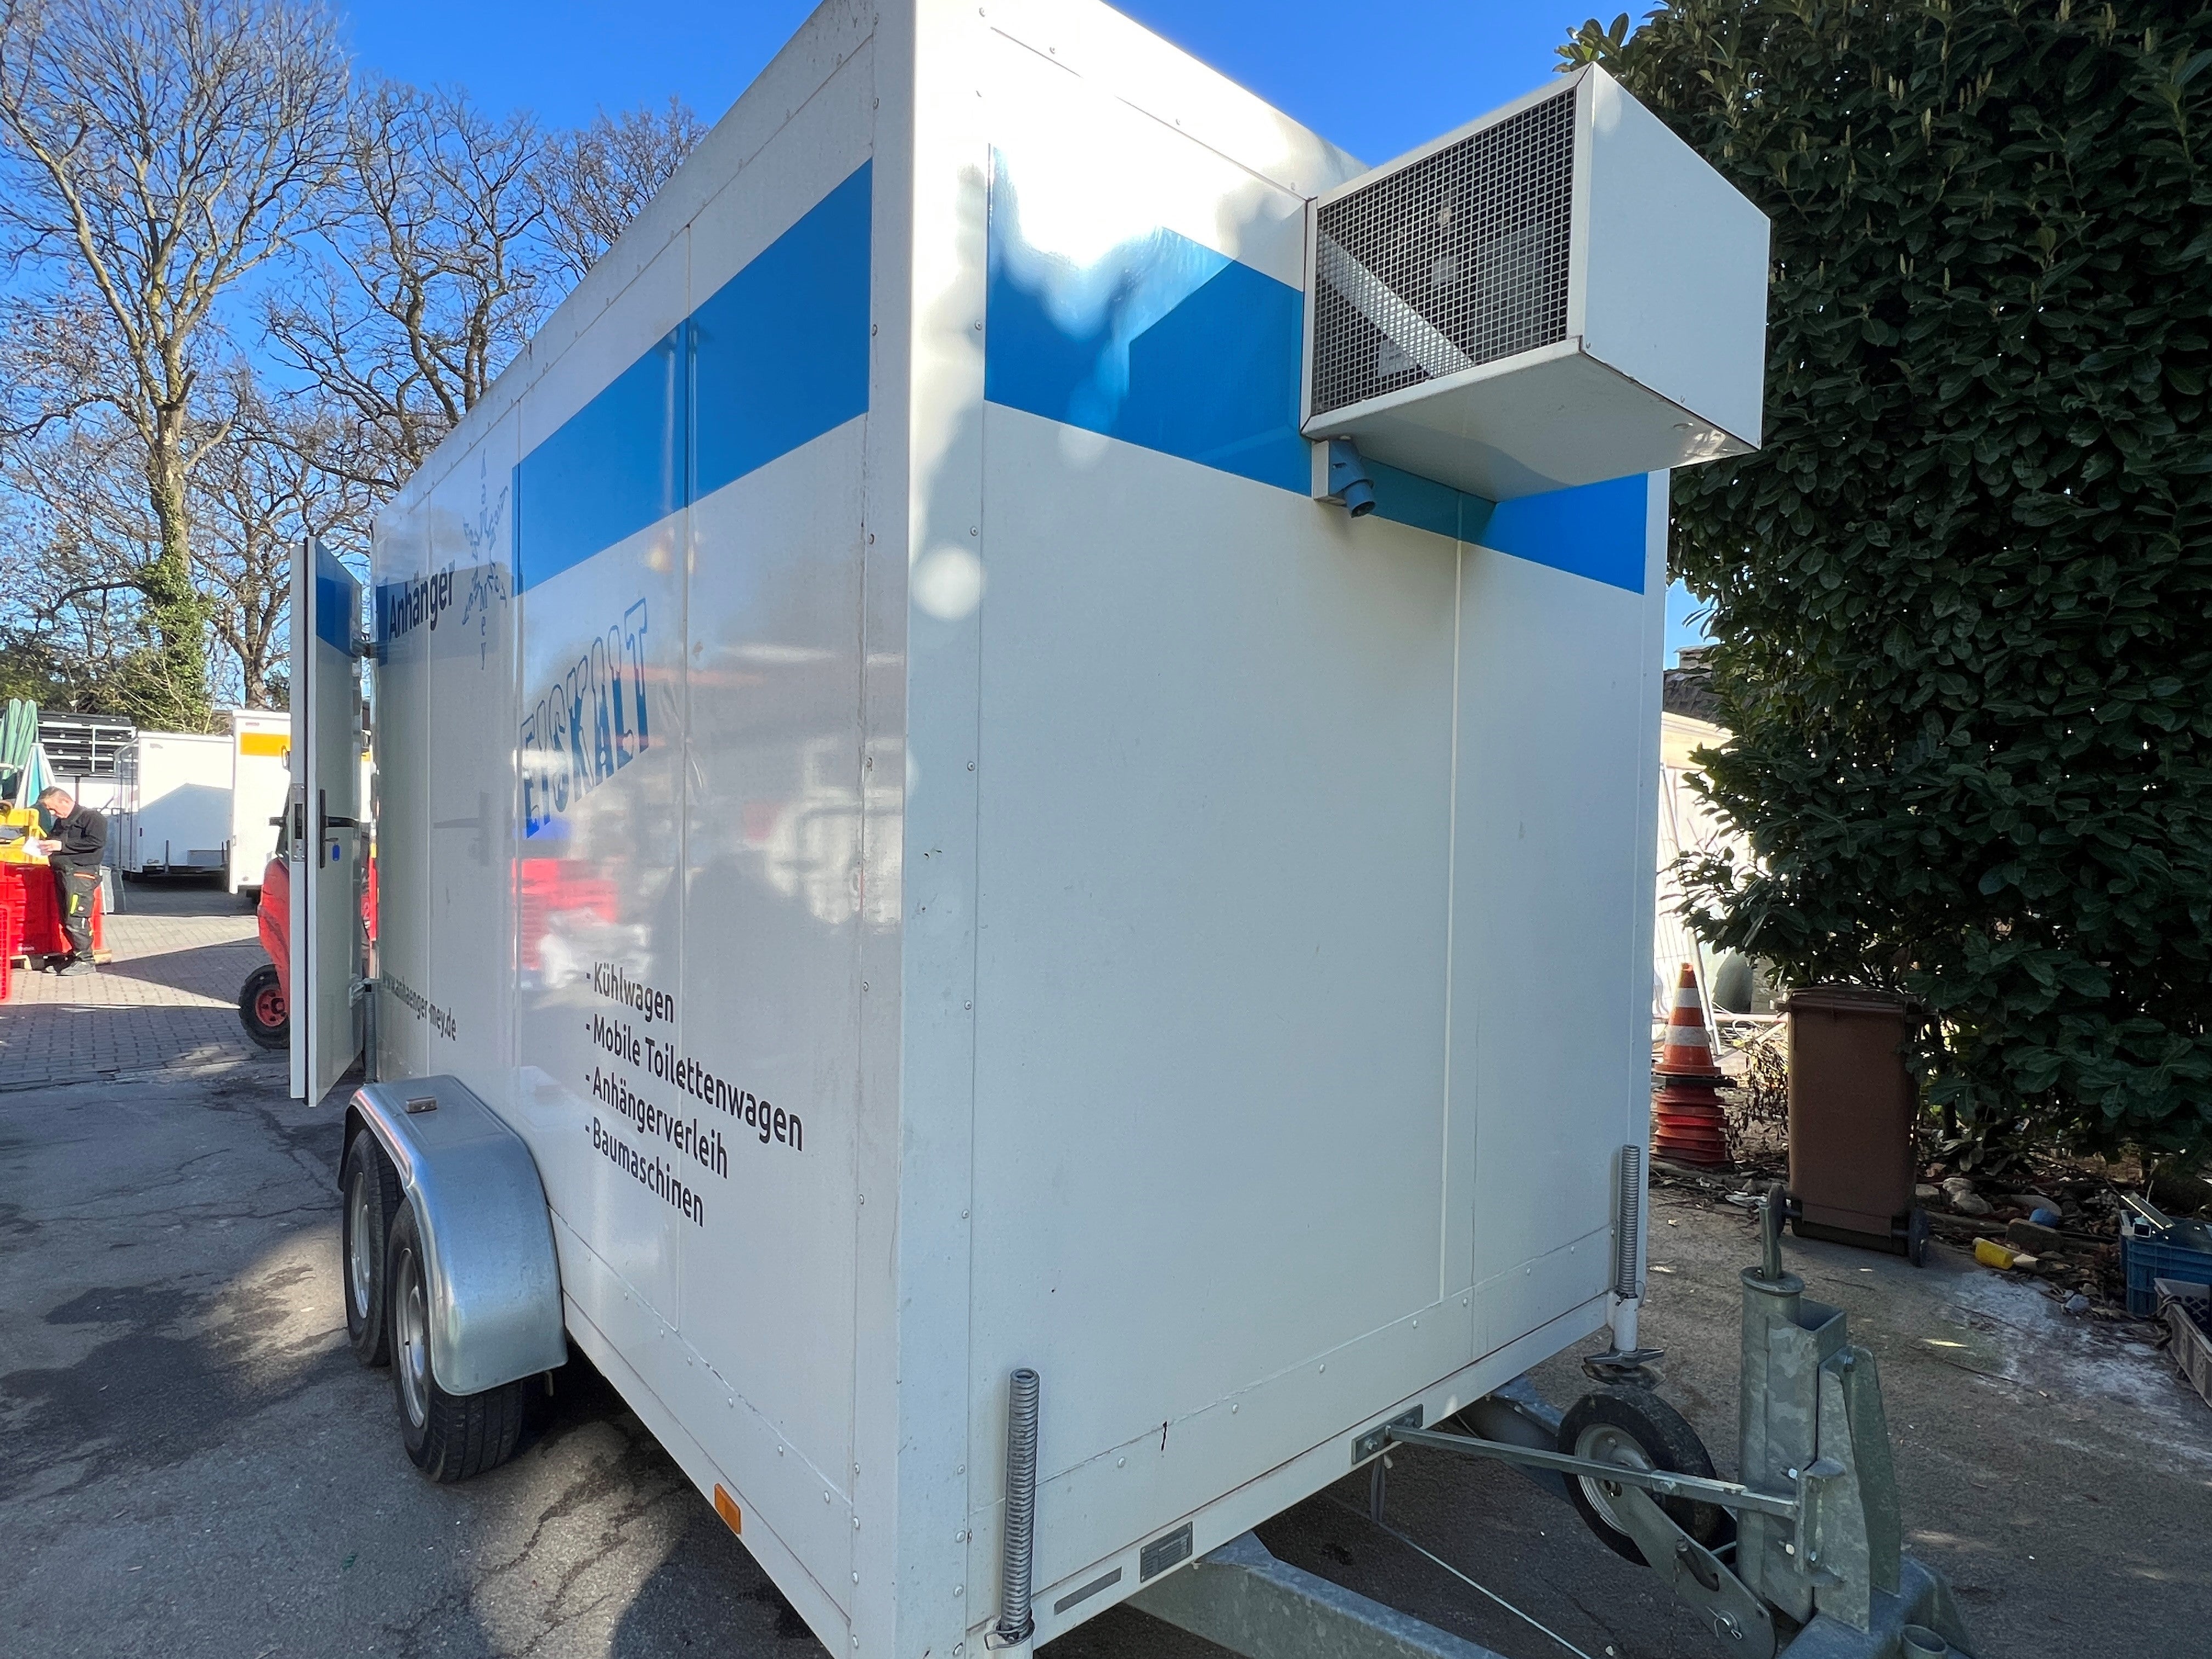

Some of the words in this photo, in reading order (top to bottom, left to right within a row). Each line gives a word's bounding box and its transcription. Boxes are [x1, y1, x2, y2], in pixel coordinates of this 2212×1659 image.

[389, 559, 455, 642] Anhänger
[520, 597, 648, 838] EISKALT
[594, 1013, 640, 1066] Mobile
[645, 1036, 803, 1152] Toilettenwagen
